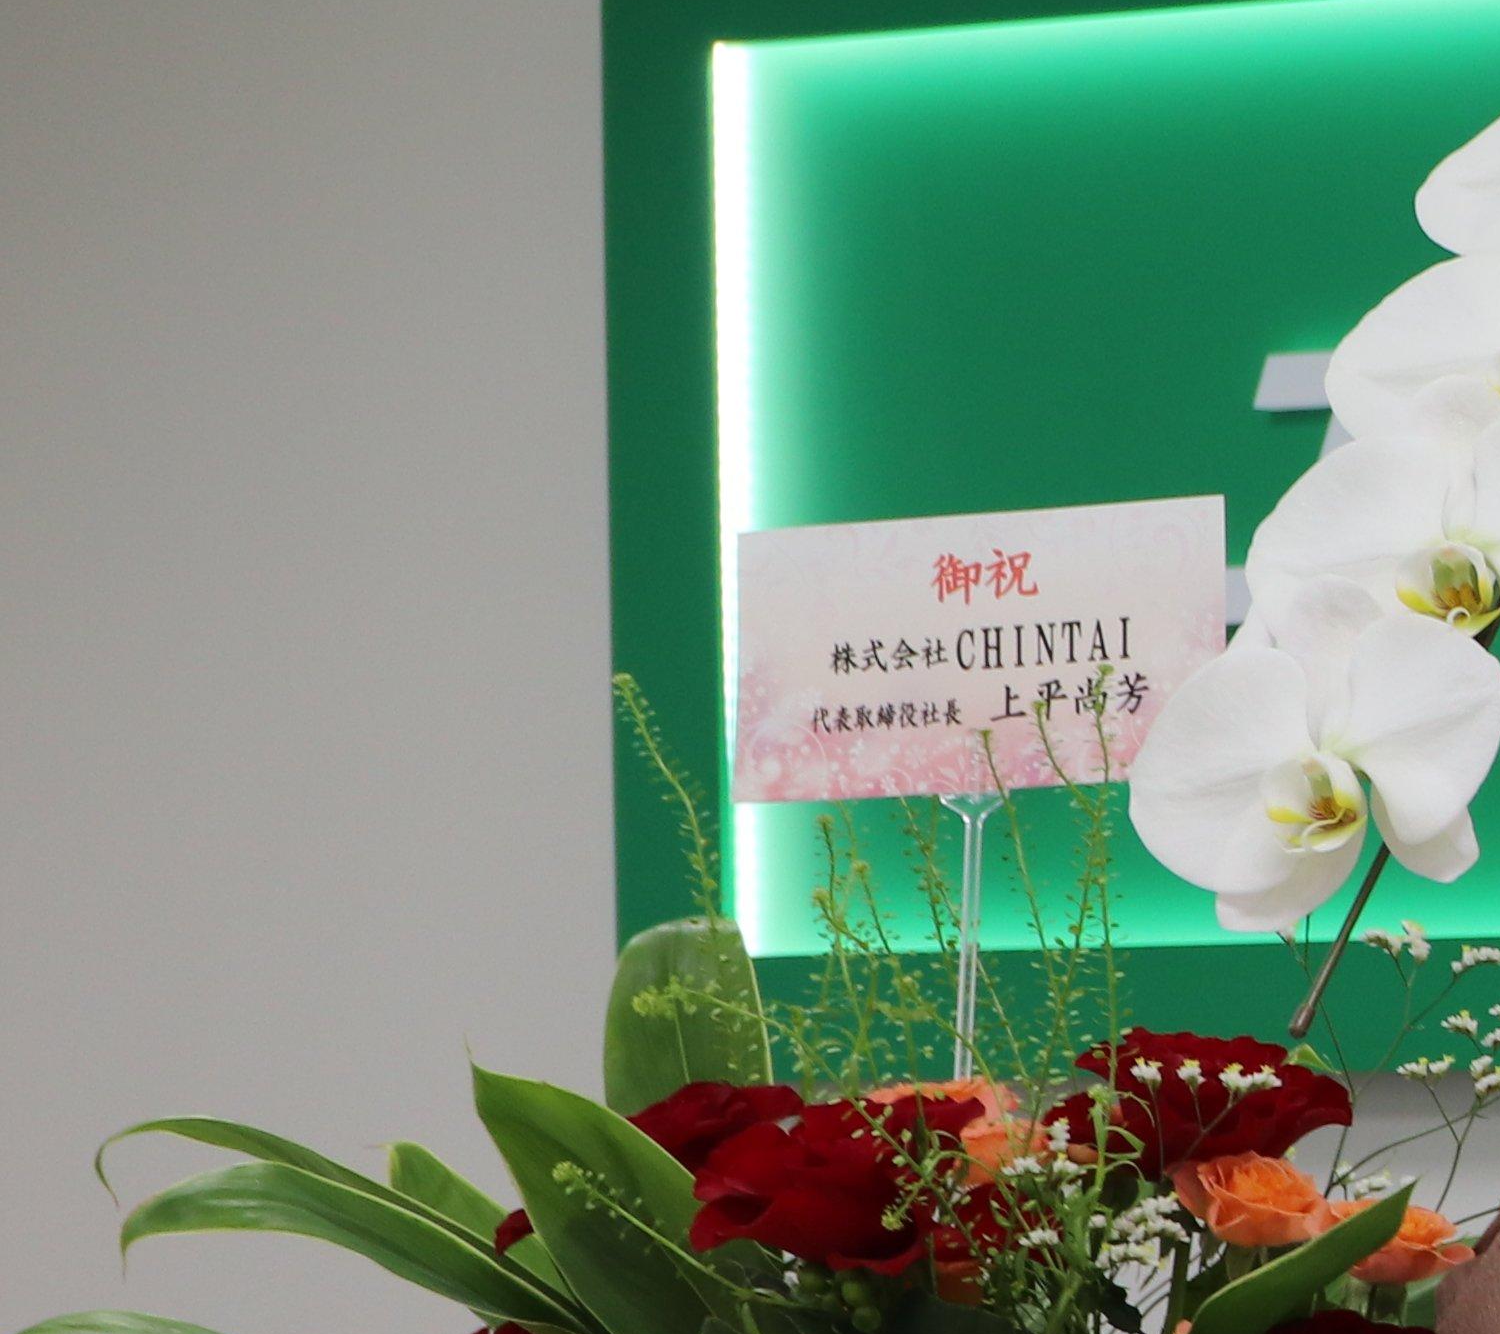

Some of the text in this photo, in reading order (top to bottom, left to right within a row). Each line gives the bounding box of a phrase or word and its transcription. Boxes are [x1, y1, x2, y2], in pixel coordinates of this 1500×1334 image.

[931, 547, 1040, 606] 御祝
[811, 697, 963, 735] 代表取締役社長
